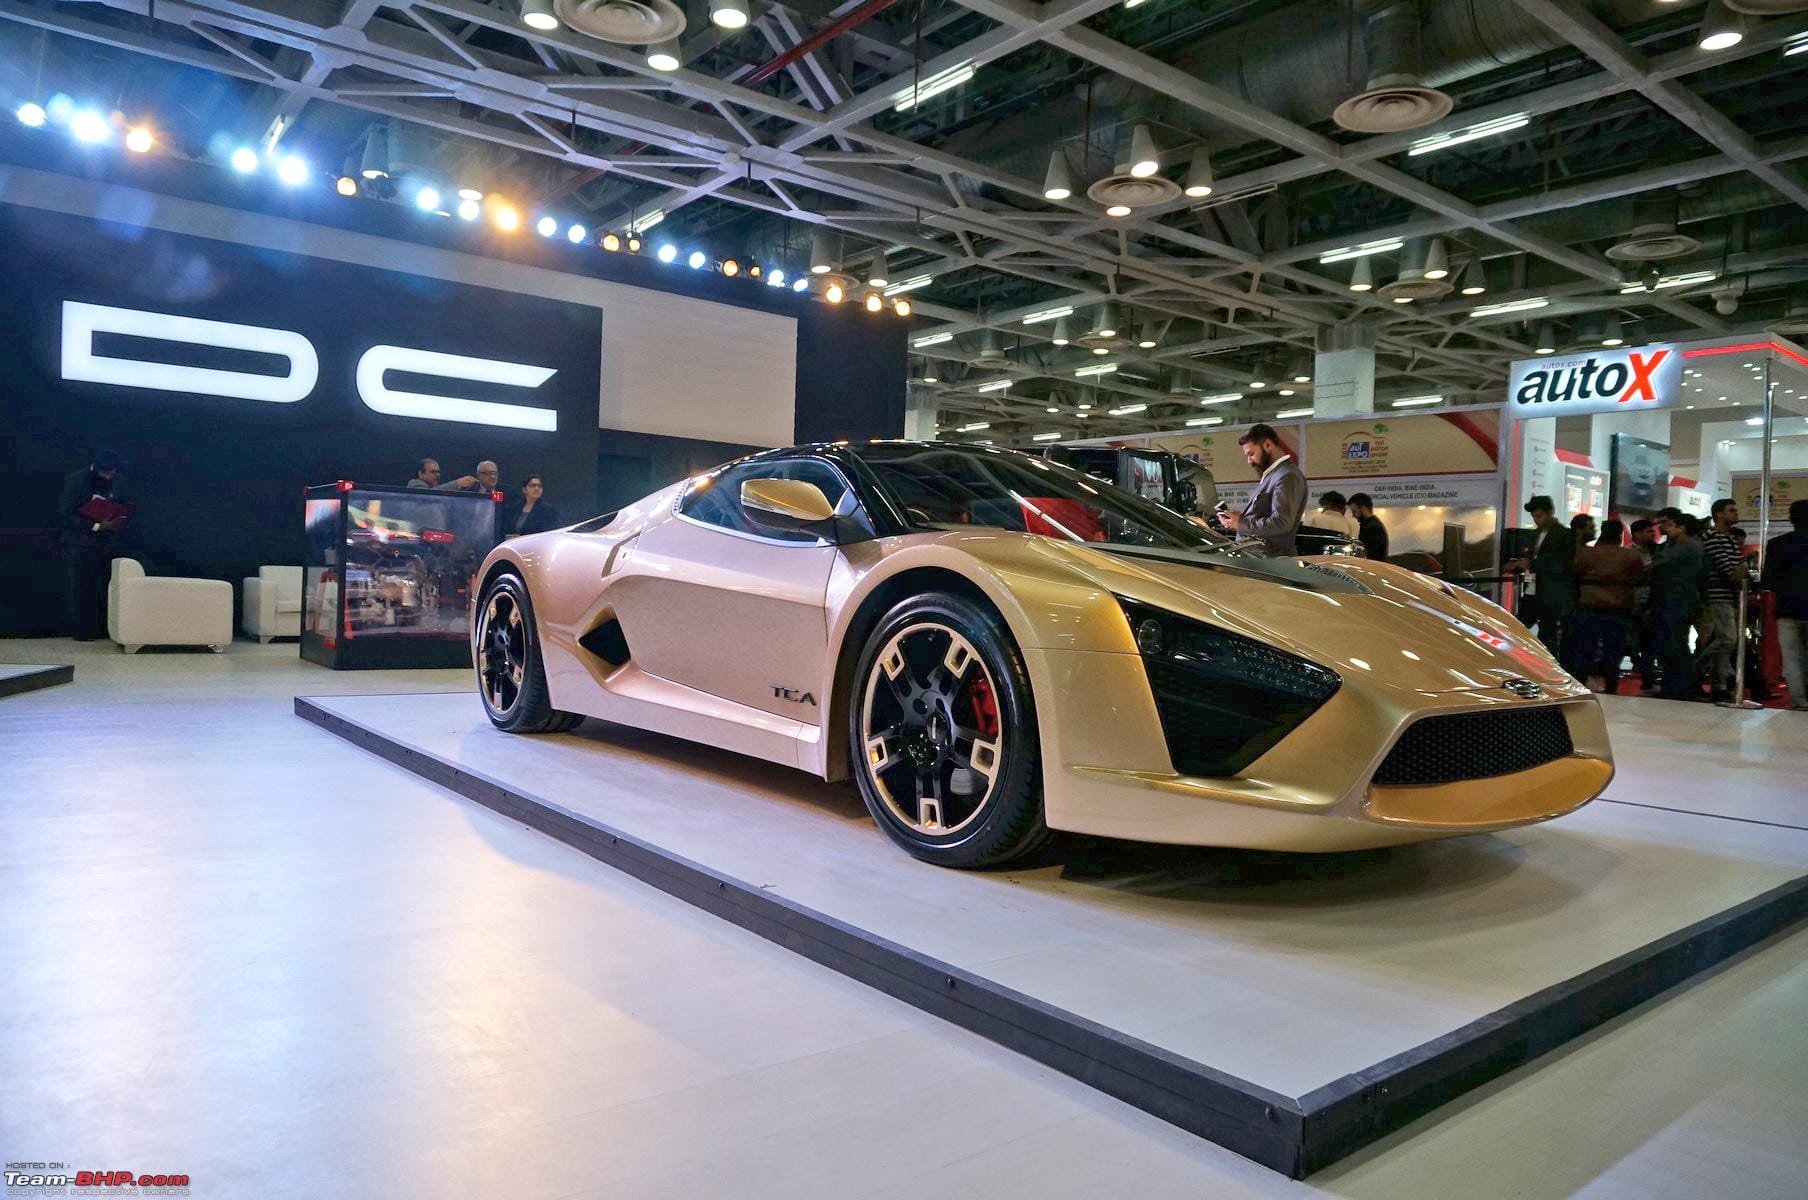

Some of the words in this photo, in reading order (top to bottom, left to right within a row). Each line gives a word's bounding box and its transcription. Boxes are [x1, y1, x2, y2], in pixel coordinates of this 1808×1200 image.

[61, 300, 558, 432] DC
[1541, 359, 1587, 370] autox.com
[1516, 349, 1673, 405] autoX
[1348, 450, 1369, 458] EXPO
[1390, 492, 1414, 500] VEHICLE
[1428, 491, 1459, 499] MAGAZINE
